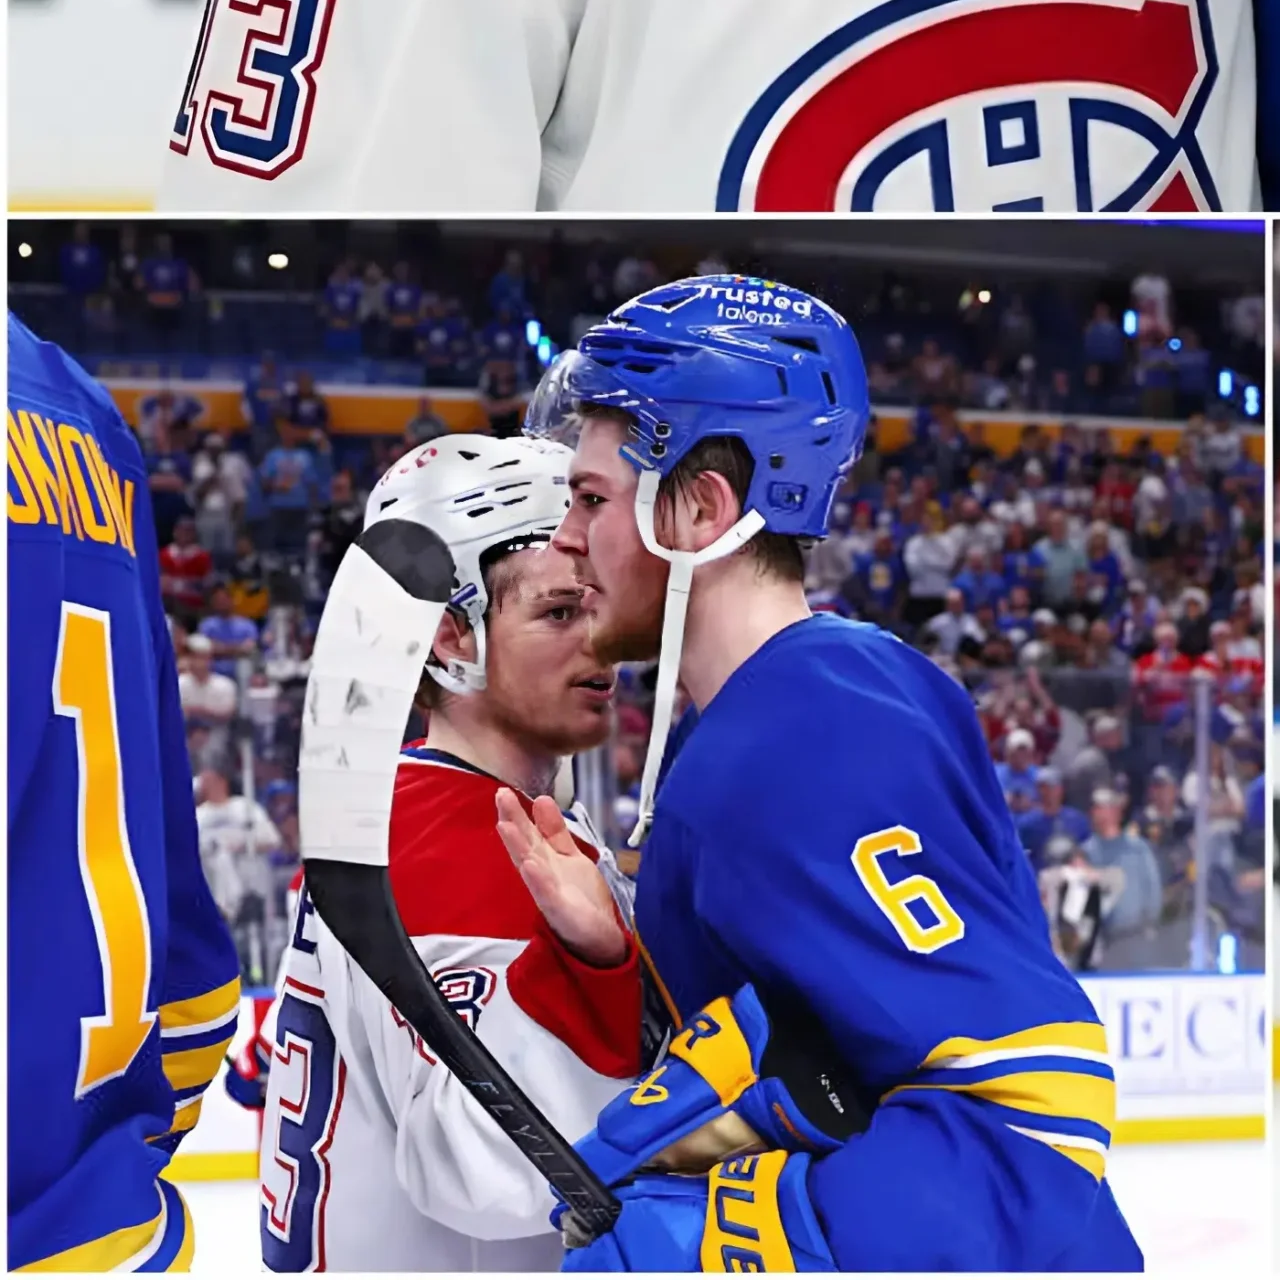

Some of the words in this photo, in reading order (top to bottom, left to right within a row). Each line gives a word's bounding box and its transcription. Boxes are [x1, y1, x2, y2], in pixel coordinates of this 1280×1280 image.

[694, 283, 812, 317] Trusted
[52, 601, 158, 1099] 1
[850, 824, 965, 955] 6
[1118, 996, 1265, 1061] EC
